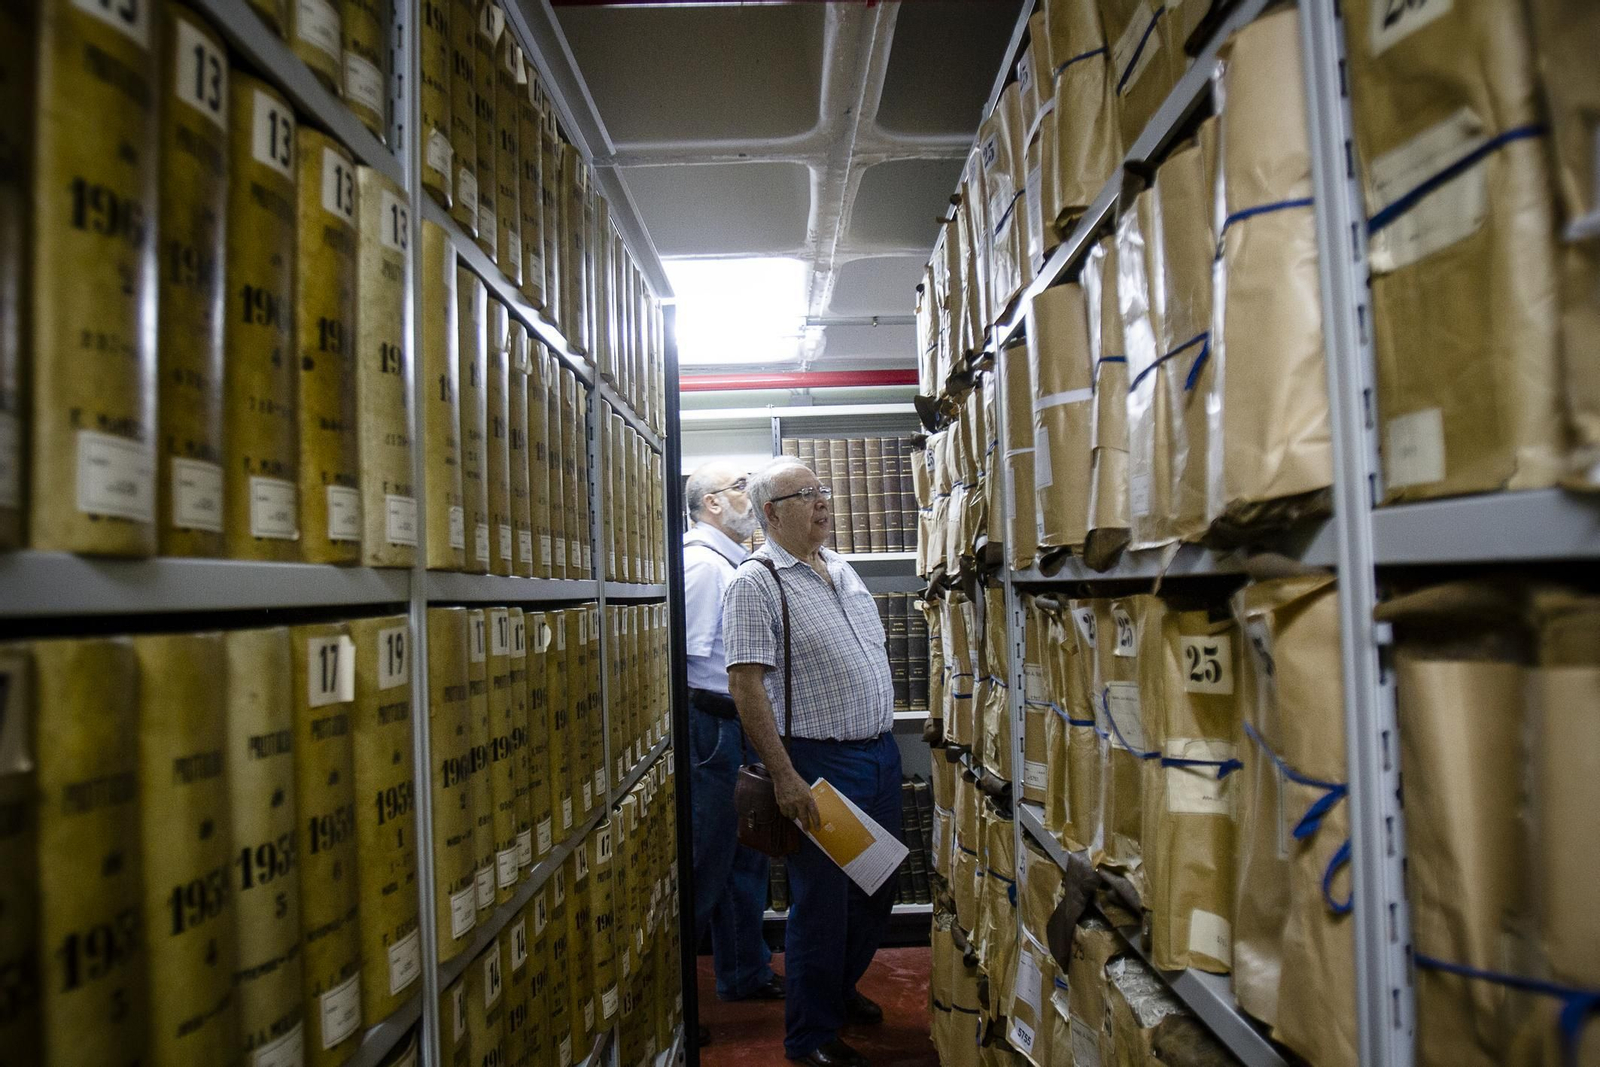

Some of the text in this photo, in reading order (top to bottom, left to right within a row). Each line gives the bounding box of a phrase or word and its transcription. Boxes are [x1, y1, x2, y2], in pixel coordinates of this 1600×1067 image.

[194, 44, 222, 113] 13
[269, 109, 292, 168] 13
[982, 139, 995, 168] 25
[333, 164, 354, 217] 13
[390, 203, 408, 250] 13
[1118, 616, 1133, 647] 25
[317, 644, 338, 693] 17
[386, 632, 404, 677] 19
[1186, 645, 1222, 684] 25
[602, 834, 610, 856] 17
[516, 926, 525, 960] 14
[490, 957, 500, 995] 14
[1017, 1027, 1032, 1047] 5755
